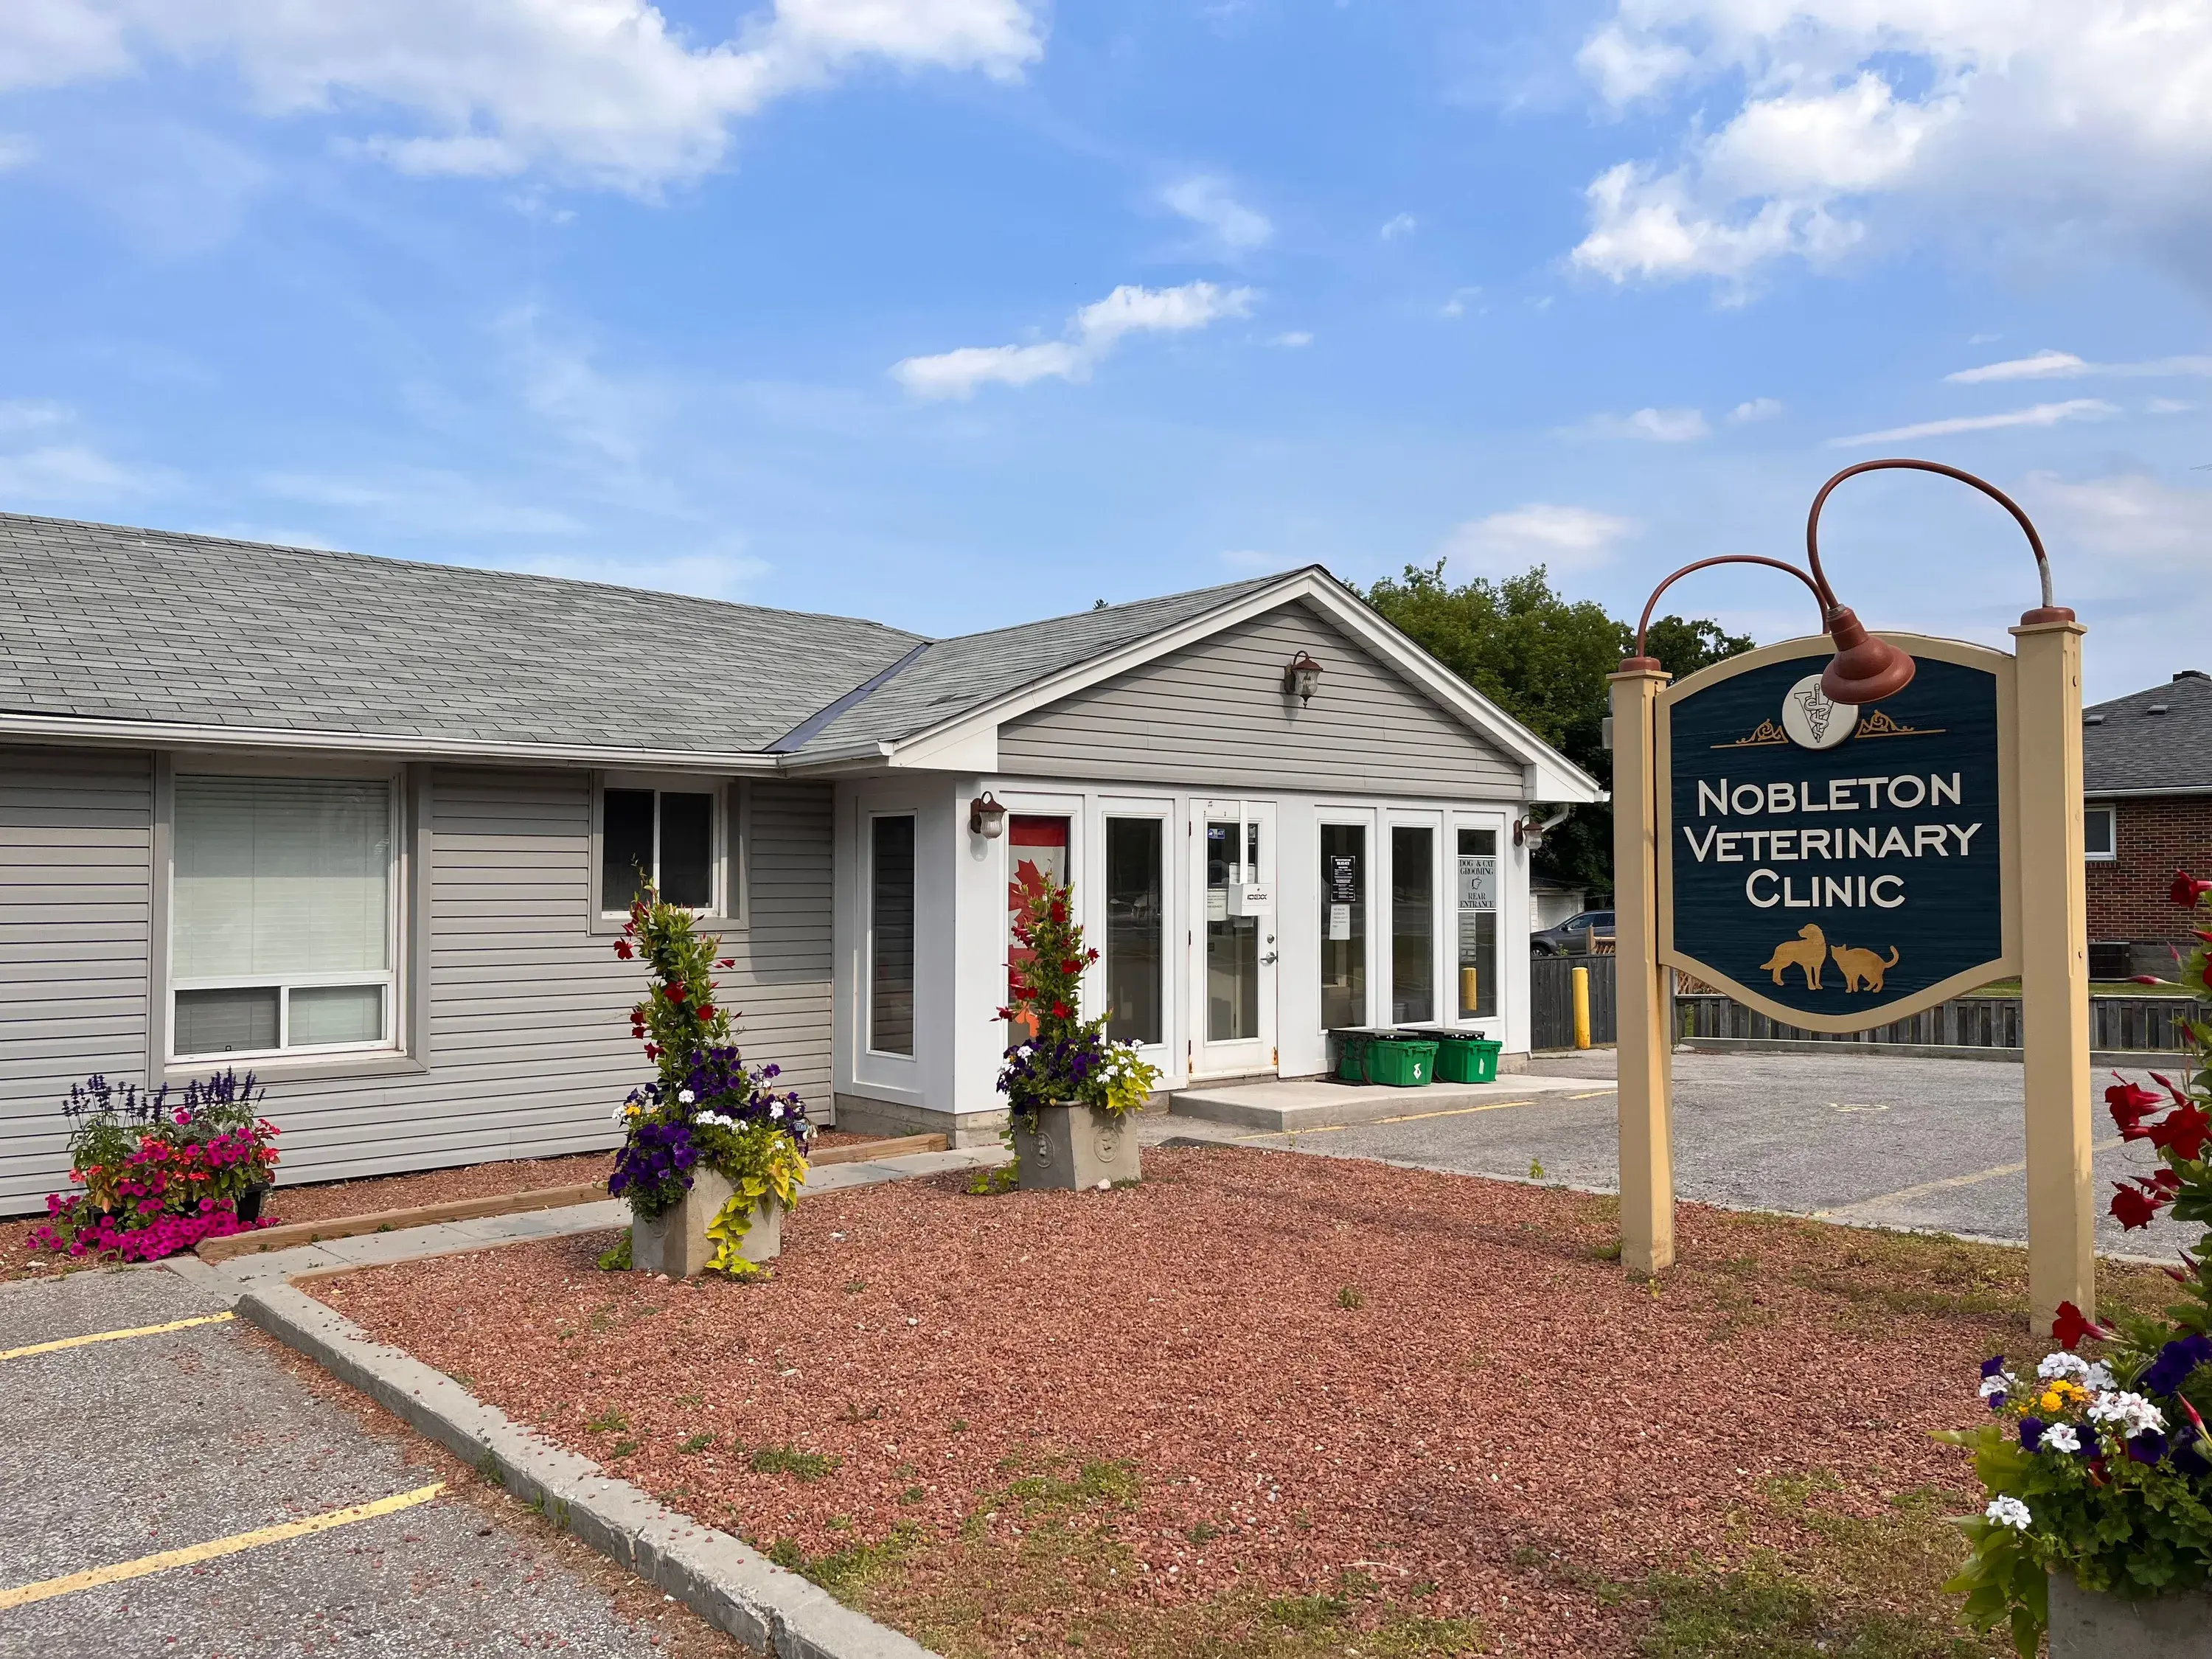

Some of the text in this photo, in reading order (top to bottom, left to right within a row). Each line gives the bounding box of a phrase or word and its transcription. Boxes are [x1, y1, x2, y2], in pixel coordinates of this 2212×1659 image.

[1698, 773, 1961, 817] NOBLETON
[1683, 824, 1983, 863] VETERINARY
[1745, 869, 1905, 908] CLINIC
